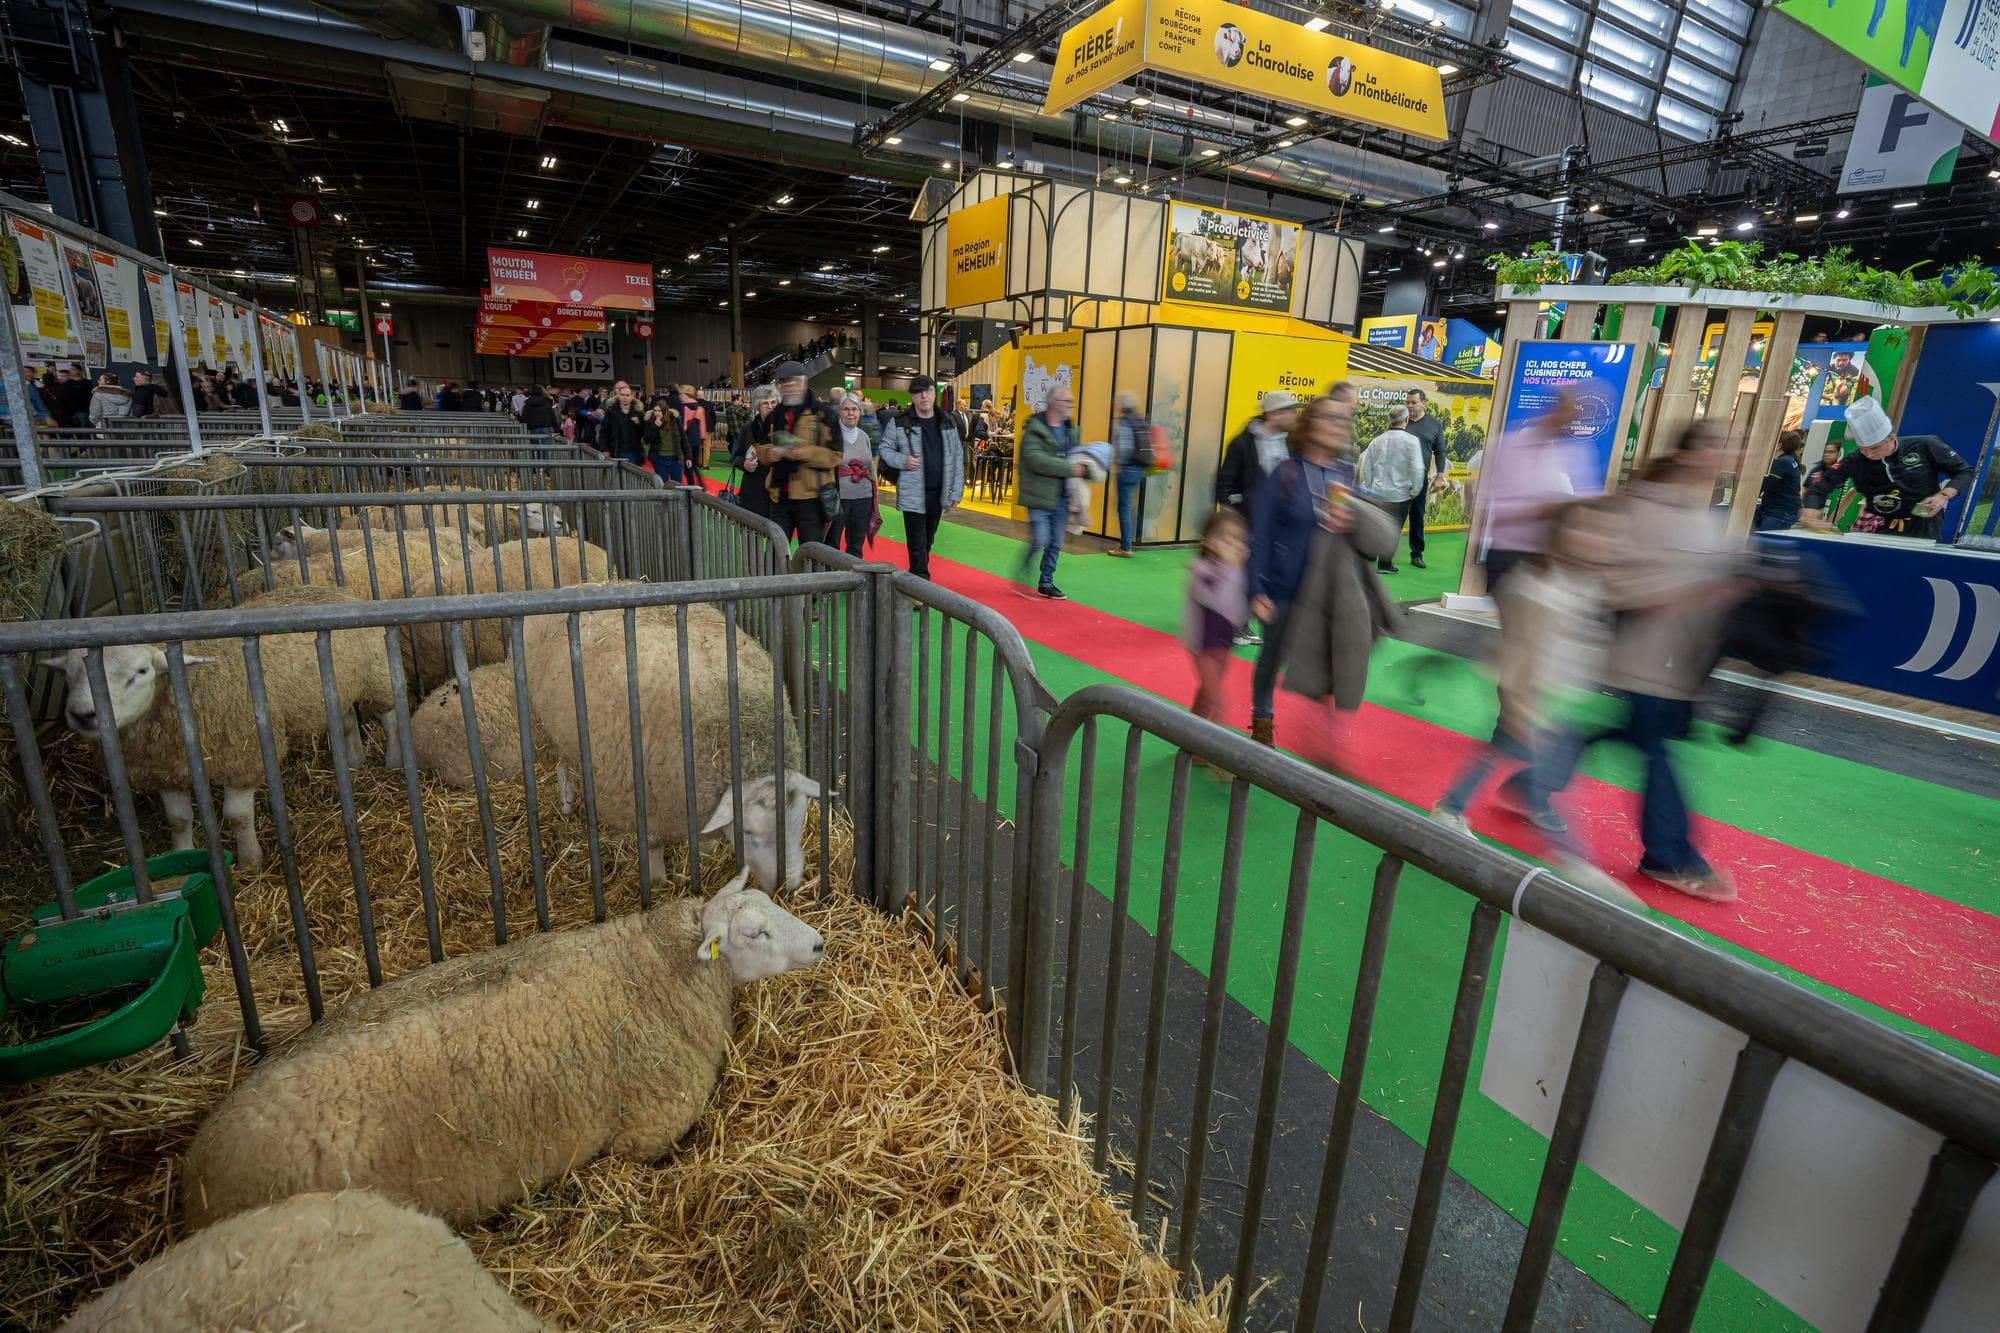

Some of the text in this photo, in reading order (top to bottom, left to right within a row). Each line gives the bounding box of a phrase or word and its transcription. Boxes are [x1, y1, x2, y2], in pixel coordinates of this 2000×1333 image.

[1160, 17, 1201, 35] BOURGOGNE
[1978, 11, 1998, 43] PAYS
[1164, 31, 1196, 46] FRANCHE
[1258, 39, 1271, 54] La
[1065, 39, 1136, 85] de nos savoir-faire
[1976, 40, 1999, 71] LOIRE
[1246, 50, 1314, 82] Charolaise
[1366, 72, 1377, 85] La
[1878, 93, 1930, 154] F
[1207, 221, 1270, 241] Productivité
[952, 238, 990, 258] ma Région
[492, 256, 534, 270] MOUTON
[493, 267, 538, 281] VENDÉEN
[624, 275, 650, 287] TEXEL
[484, 302, 513, 312] L'OUEST
[557, 307, 604, 318] DORSET DOWN
[576, 340, 607, 353] 4 5
[558, 357, 589, 371] 6 7
[1540, 360, 1558, 369] NOS
[1559, 361, 1587, 369] CHEFS
[1524, 368, 1593, 378] CUISINENT POUR
[1523, 376, 1578, 385] NOS LYCÉENS
[1358, 387, 1408, 400] La Charola
